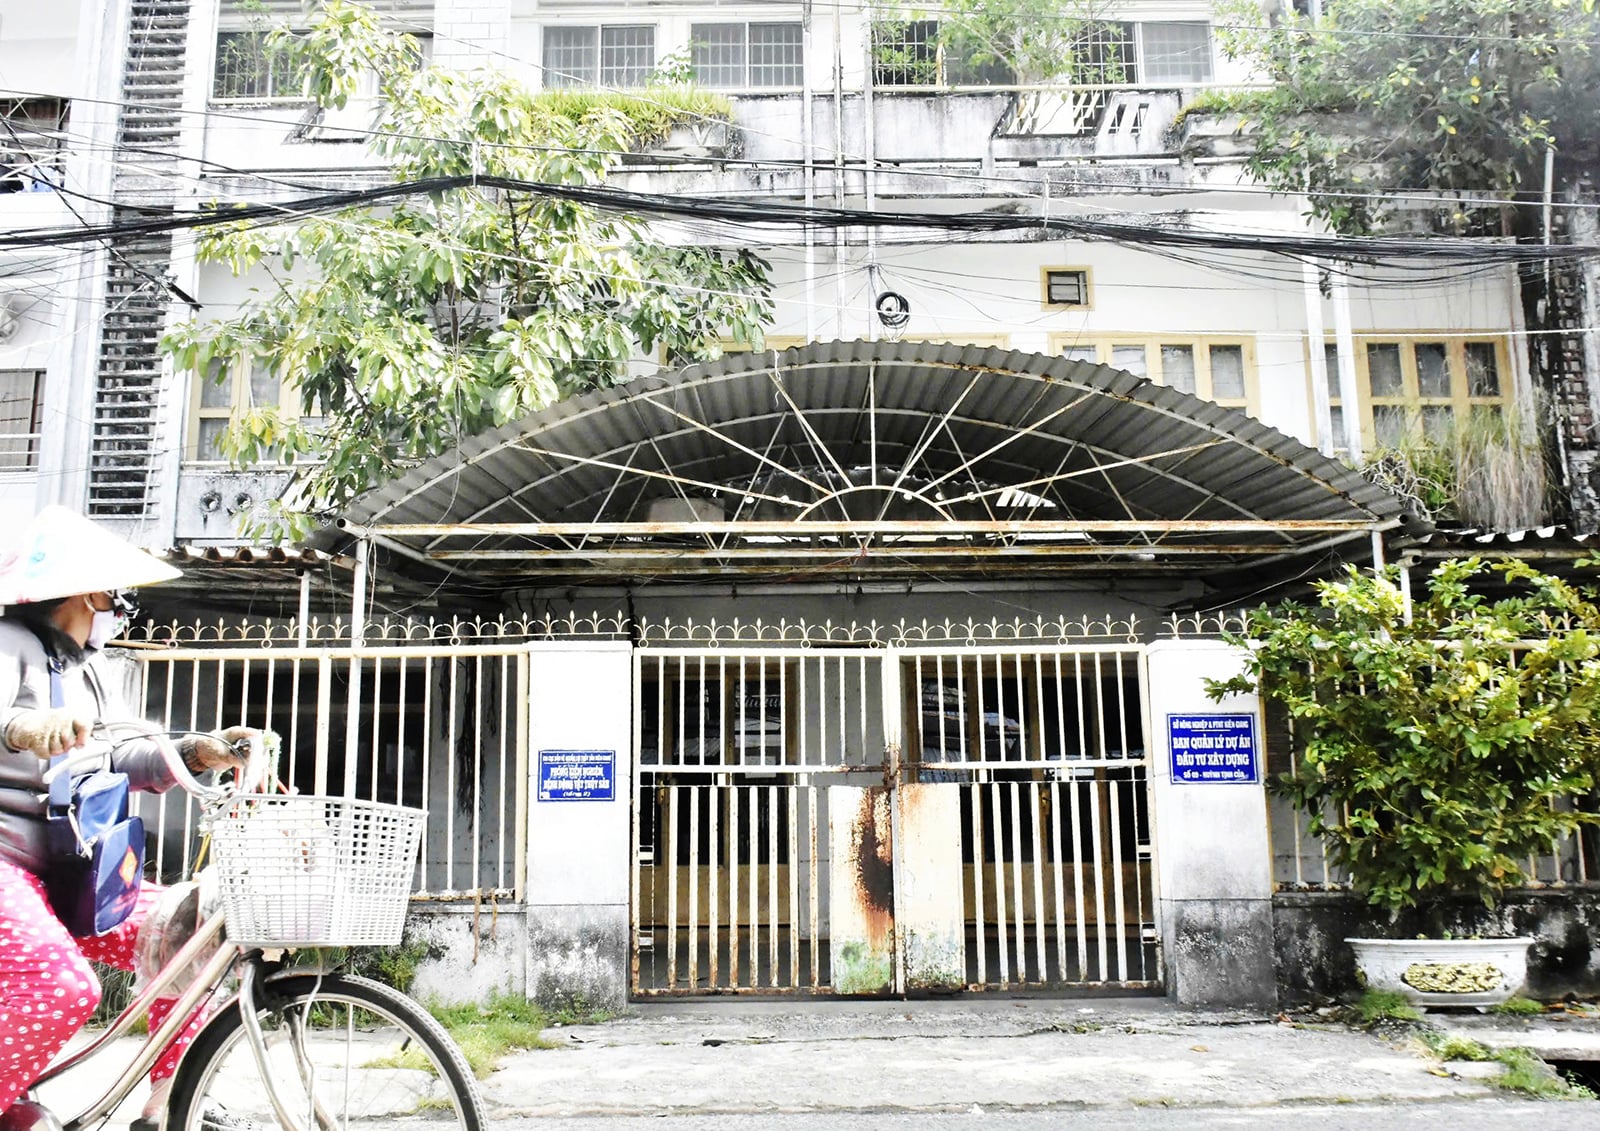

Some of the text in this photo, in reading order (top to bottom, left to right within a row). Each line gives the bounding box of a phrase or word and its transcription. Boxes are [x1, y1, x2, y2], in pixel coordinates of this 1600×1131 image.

[1173, 734, 1250, 750] BAN QUẢN LÝ DỰ ÁN
[1195, 753, 1206, 765] TƯ
[1208, 752, 1224, 765] XÂY
[1226, 753, 1249, 768] DỰNG
